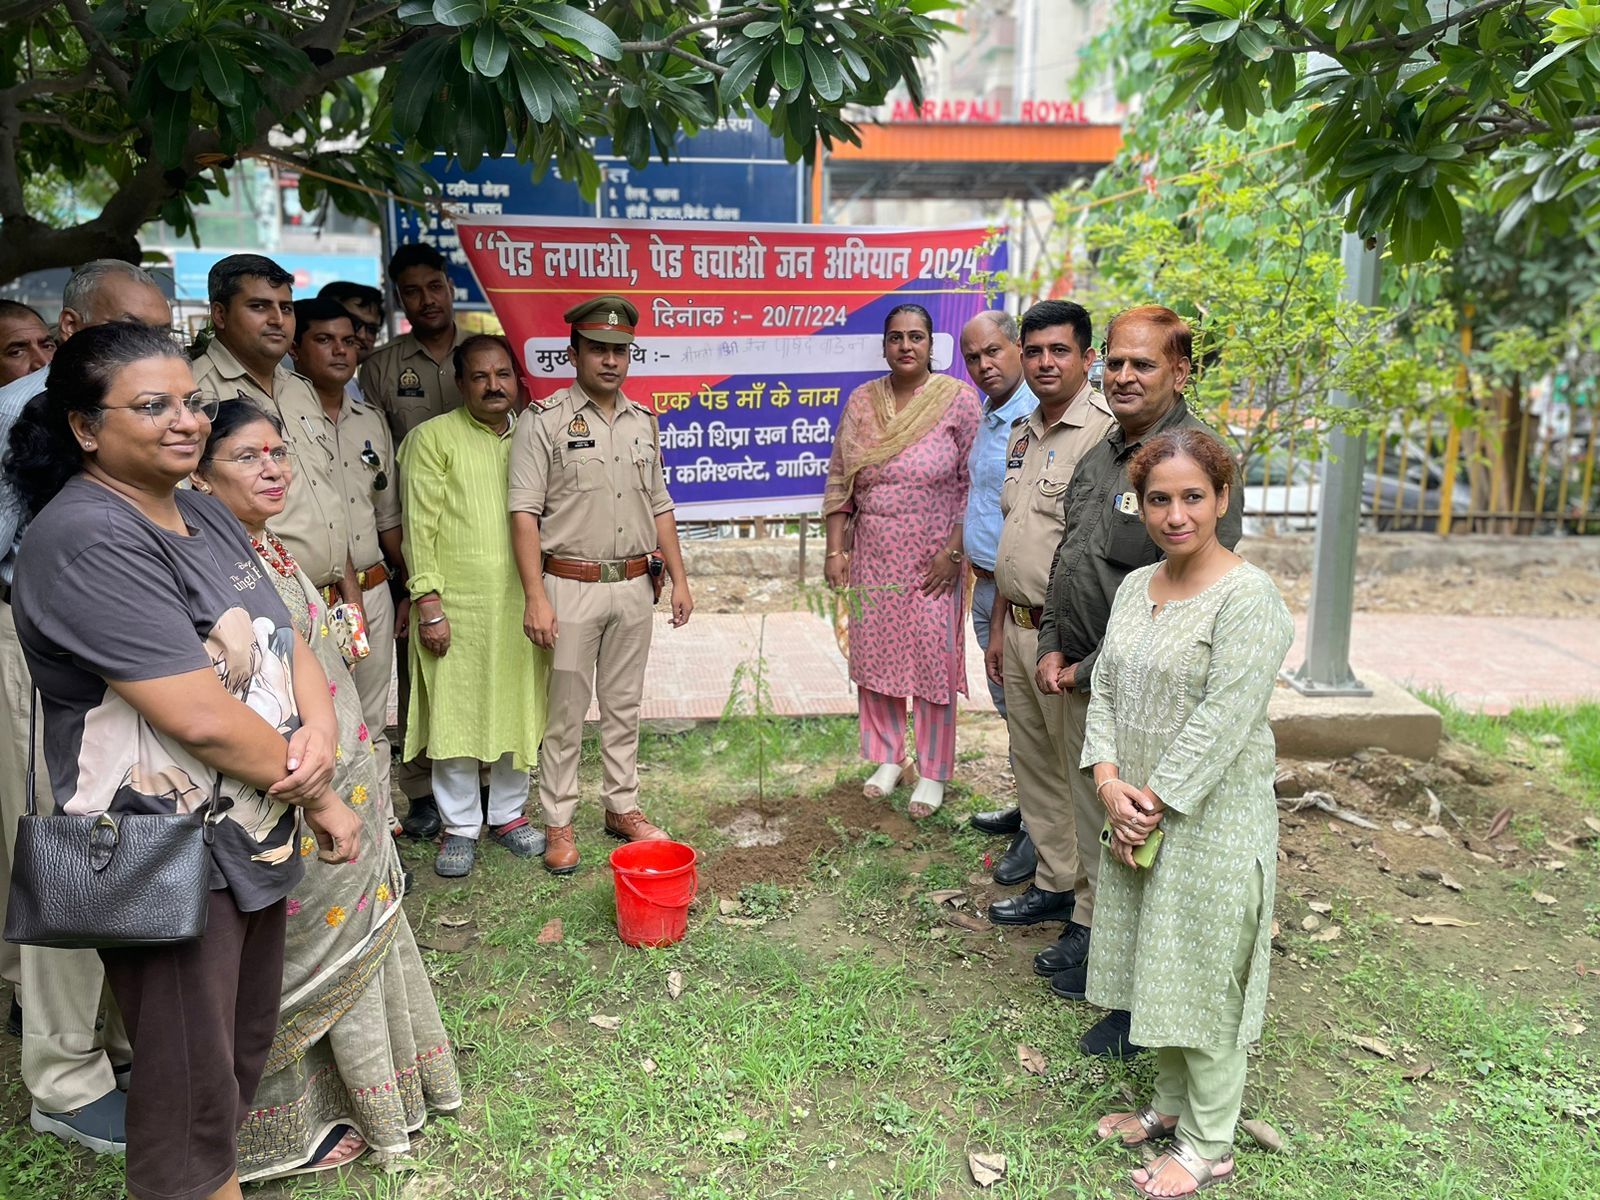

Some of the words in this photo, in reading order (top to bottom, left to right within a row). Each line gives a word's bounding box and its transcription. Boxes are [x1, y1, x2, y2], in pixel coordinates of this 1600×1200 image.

[1021, 100, 1089, 123] ROYAL
[541, 233, 638, 286] लगाओ,
[649, 234, 684, 278] पेड
[691, 236, 767, 279] बचाओ
[774, 246, 815, 279] जन
[824, 237, 912, 280] अभियान
[652, 297, 724, 328] दिनांक
[762, 305, 847, 327] 20/7/224
[535, 350, 570, 372] मुख
[652, 391, 690, 413] एक
[698, 383, 729, 410] पेड
[735, 382, 766, 409] माँ
[770, 381, 791, 408] के
[798, 387, 840, 407] नाम
[708, 421, 750, 450] शिप्रा
[755, 426, 787, 445] सन
[791, 417, 835, 444] सिटी,
[673, 455, 770, 484] कमिश्नरेट,
[776, 452, 831, 478] गाजिय
